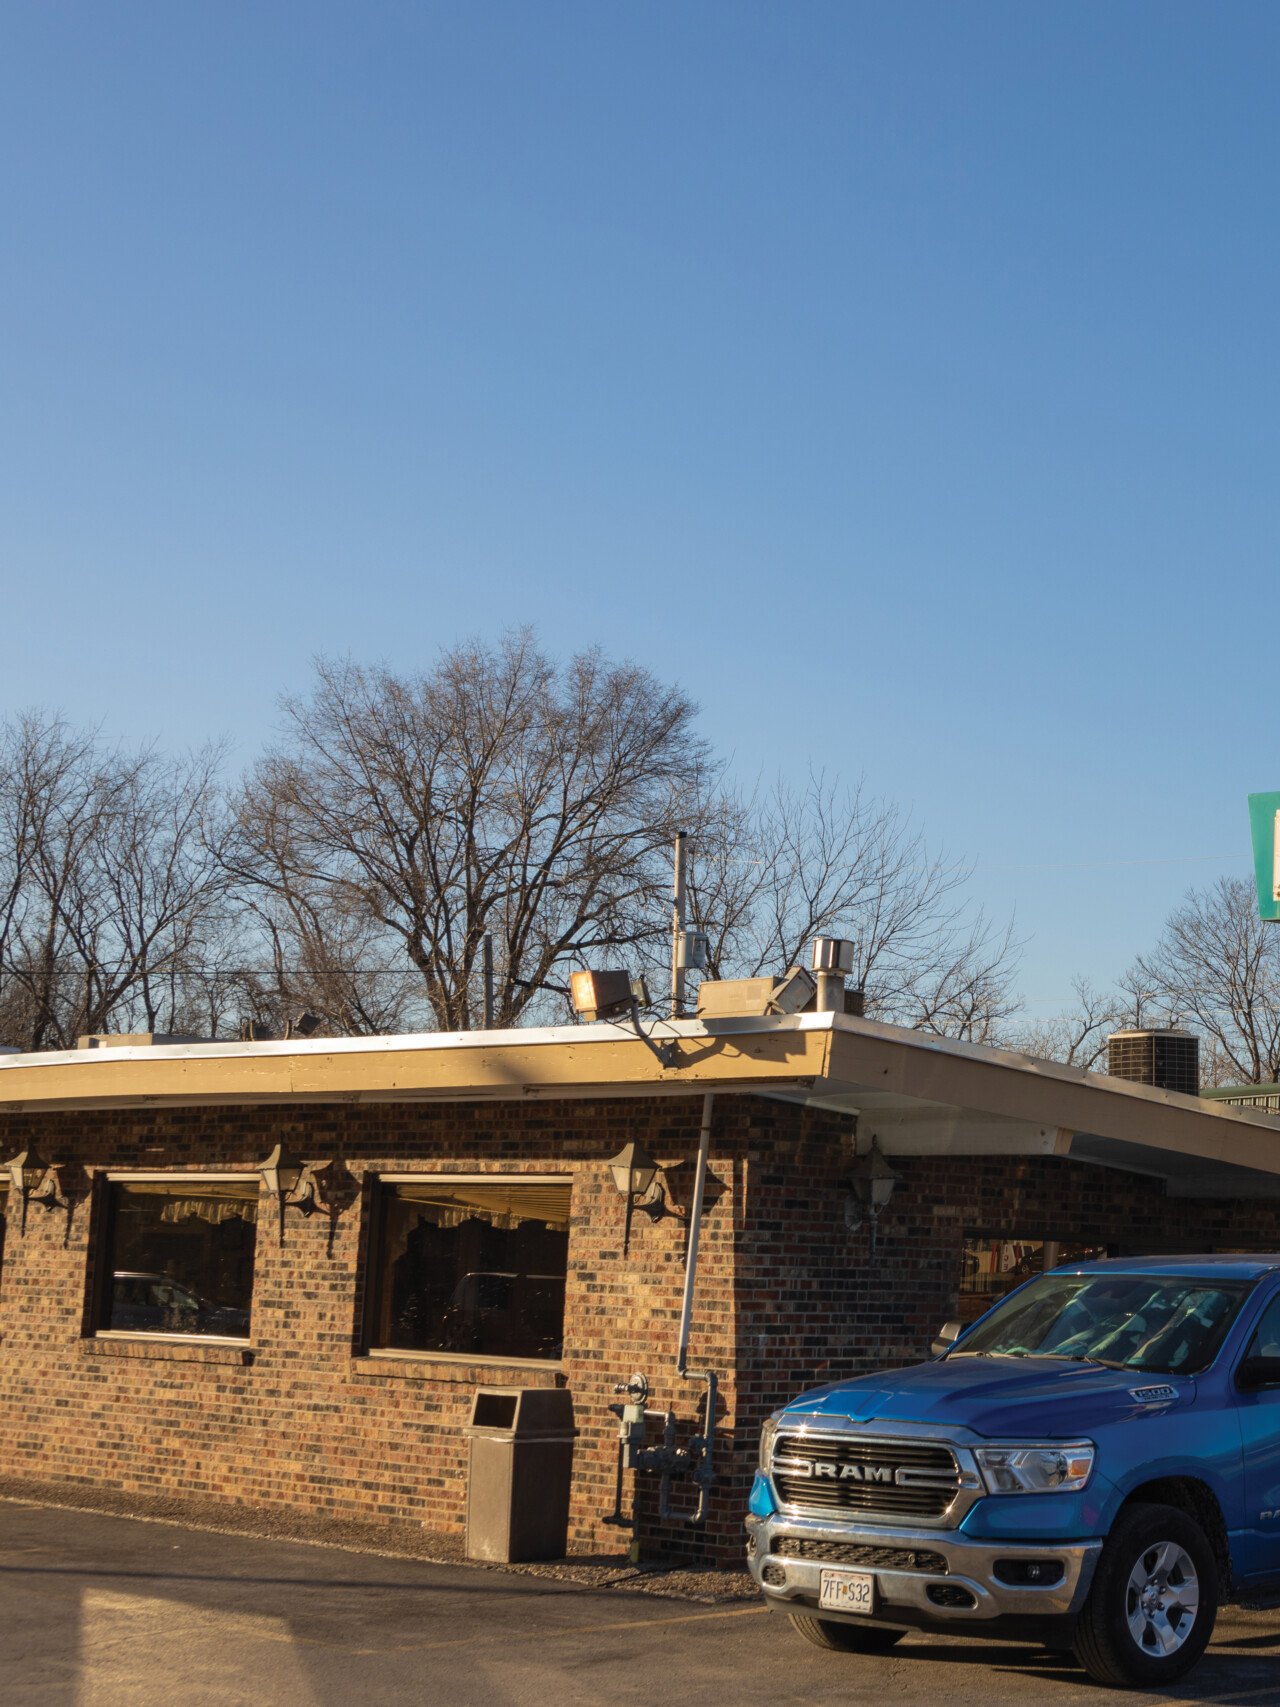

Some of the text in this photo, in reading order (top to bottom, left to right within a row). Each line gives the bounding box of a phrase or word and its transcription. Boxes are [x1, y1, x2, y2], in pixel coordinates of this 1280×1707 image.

[1137, 1387, 1171, 1398] 1500
[815, 1462, 893, 1482] RAM
[823, 1580, 870, 1603] 7FF S32
